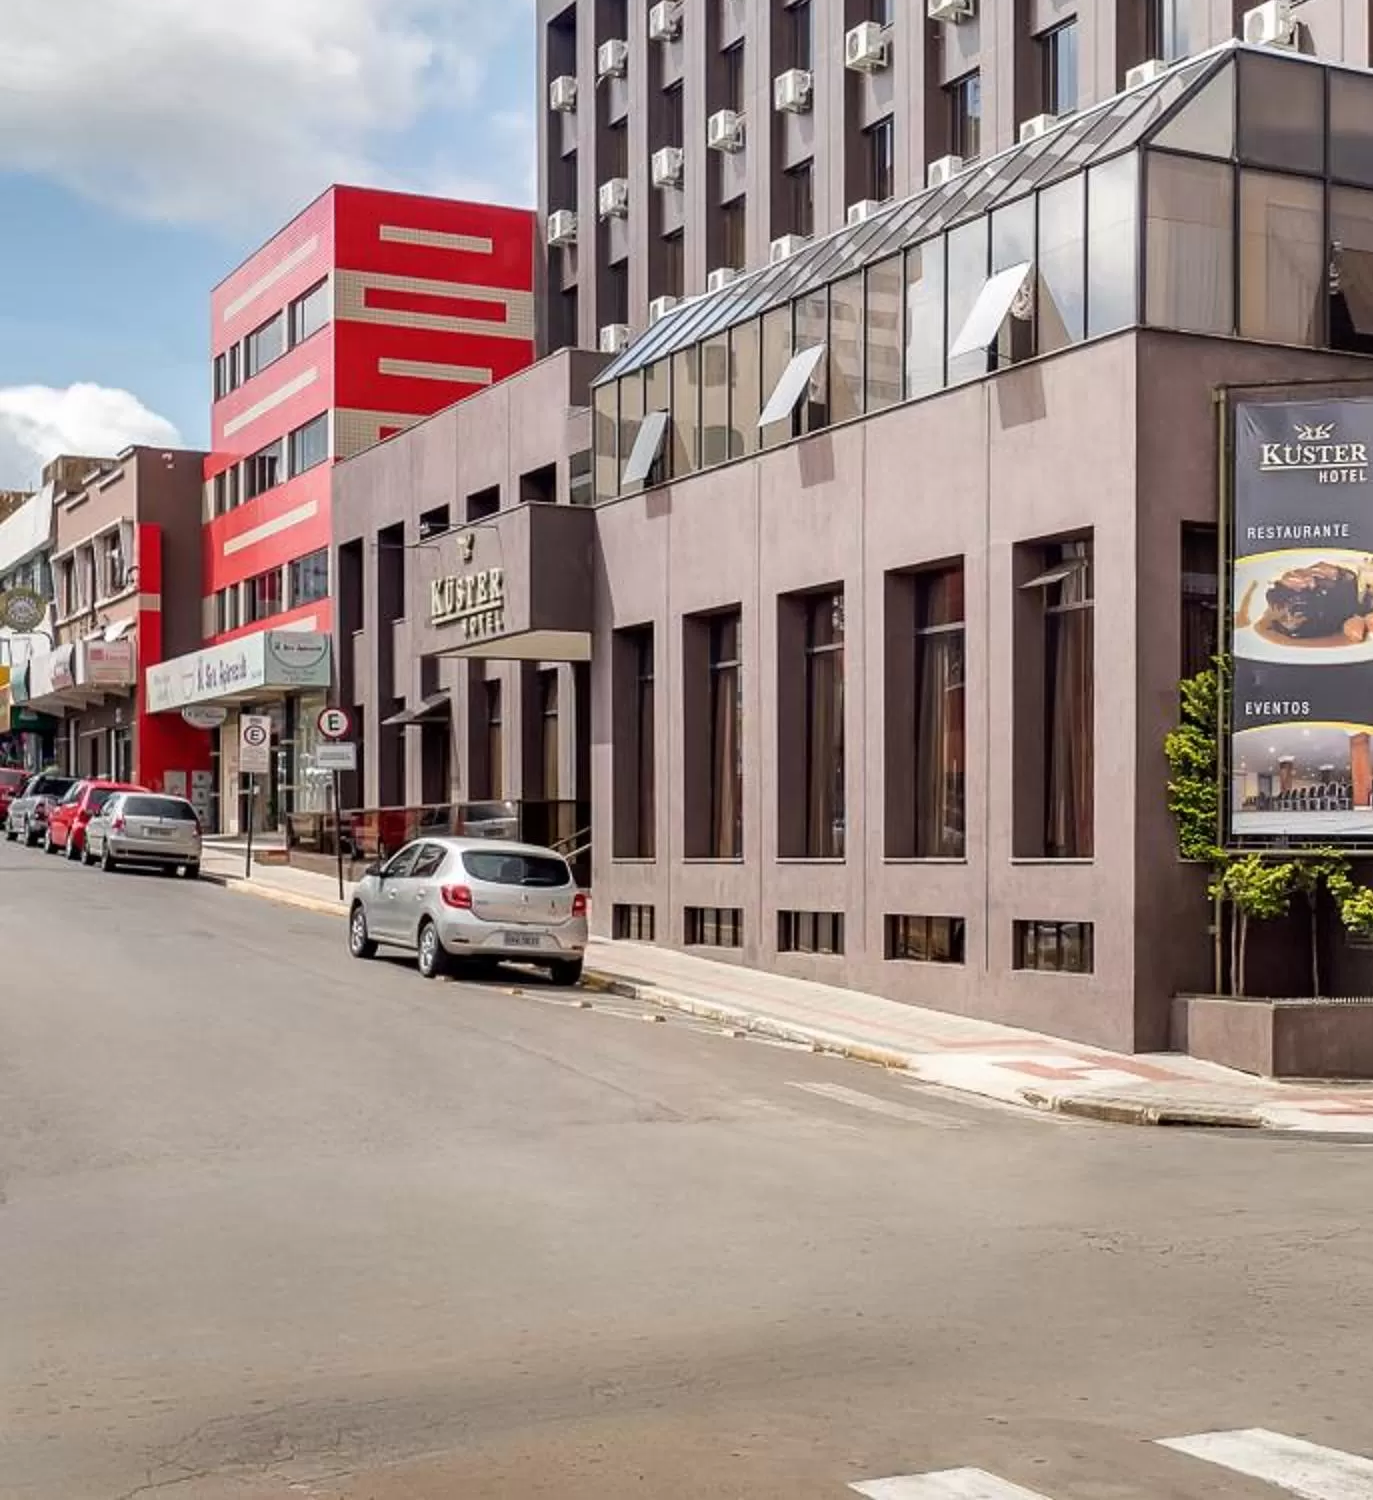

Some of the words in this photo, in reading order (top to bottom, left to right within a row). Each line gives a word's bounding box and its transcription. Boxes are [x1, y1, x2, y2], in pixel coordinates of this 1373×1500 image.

[1319, 469, 1368, 483] HOTEL
[1247, 524, 1349, 539] RESTAURANTE
[1245, 701, 1309, 715] EVENTOS
[327, 713, 340, 731] E
[251, 729, 260, 740] E
